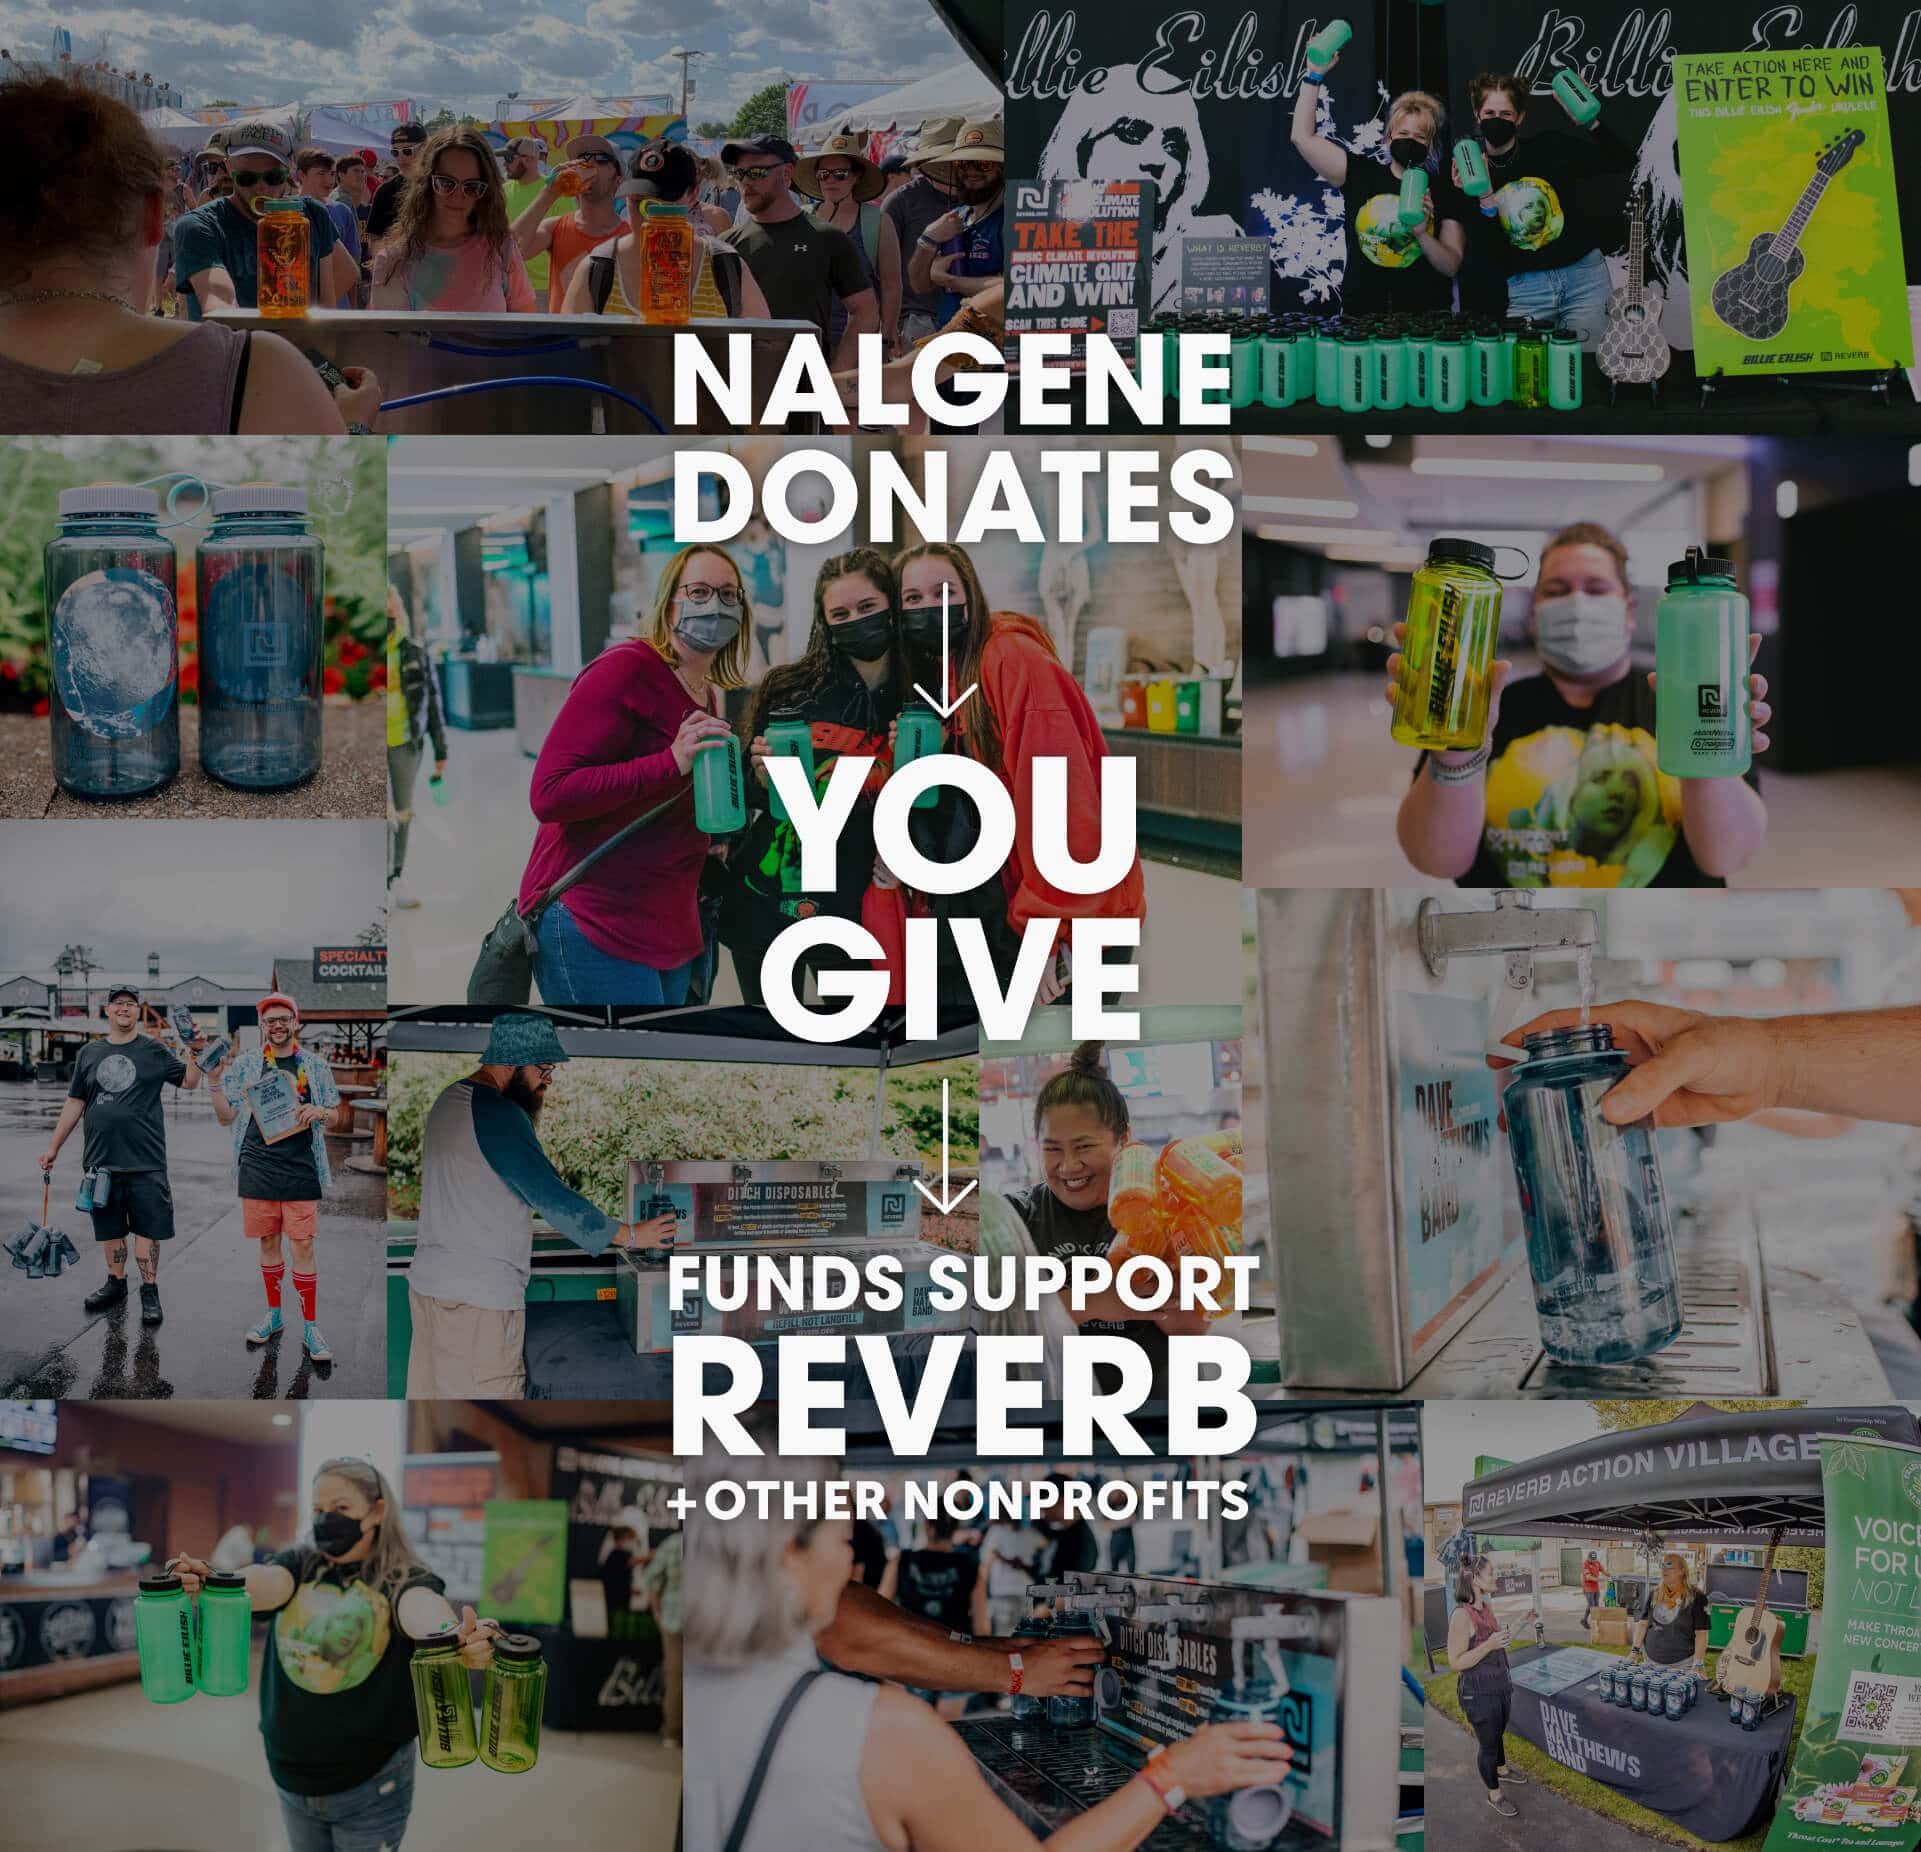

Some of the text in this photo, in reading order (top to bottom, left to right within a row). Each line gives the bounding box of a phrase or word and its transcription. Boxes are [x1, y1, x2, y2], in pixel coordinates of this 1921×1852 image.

[1003, 9, 1098, 99] llie
[1513, 7, 1678, 97] Billi
[1684, 55, 1870, 76] TAKE ACTION HERE AND
[1685, 72, 1875, 102] ENTER TO WIN
[1090, 205, 1139, 217] OLUTION
[1097, 193, 1140, 206] LIMATE
[1013, 220, 1139, 249] TAKE THE
[1010, 262, 1136, 284] CLIMATE QUIZ
[1006, 281, 1135, 309] AND WIN!
[1743, 352, 1814, 365] BILLIE EILISH
[730, 776, 740, 811] BILLIE
[1415, 1080, 1453, 1132] DAVE
[727, 1186, 761, 1201] DITCH
[1420, 1183, 1459, 1245] BAND
[773, 1319, 800, 1329] REFILL
[802, 1317, 817, 1327] NOT
[1487, 1432, 1821, 1509] REVERB ACTION VILLAGE
[1855, 1547, 1907, 1576] FOR
[1852, 1578, 1908, 1605] NOT
[1843, 1633, 1872, 1647] NEW
[1847, 1619, 1881, 1633] MAKE
[180, 1610, 193, 1684] BILLIE EILISH
[1120, 1623, 1217, 1676] DITCH DISPSABLES
[1539, 1699, 1579, 1737] DAVE
[1542, 1720, 1641, 1778] MATTHEWS
[1547, 1740, 1587, 1774] BAND
